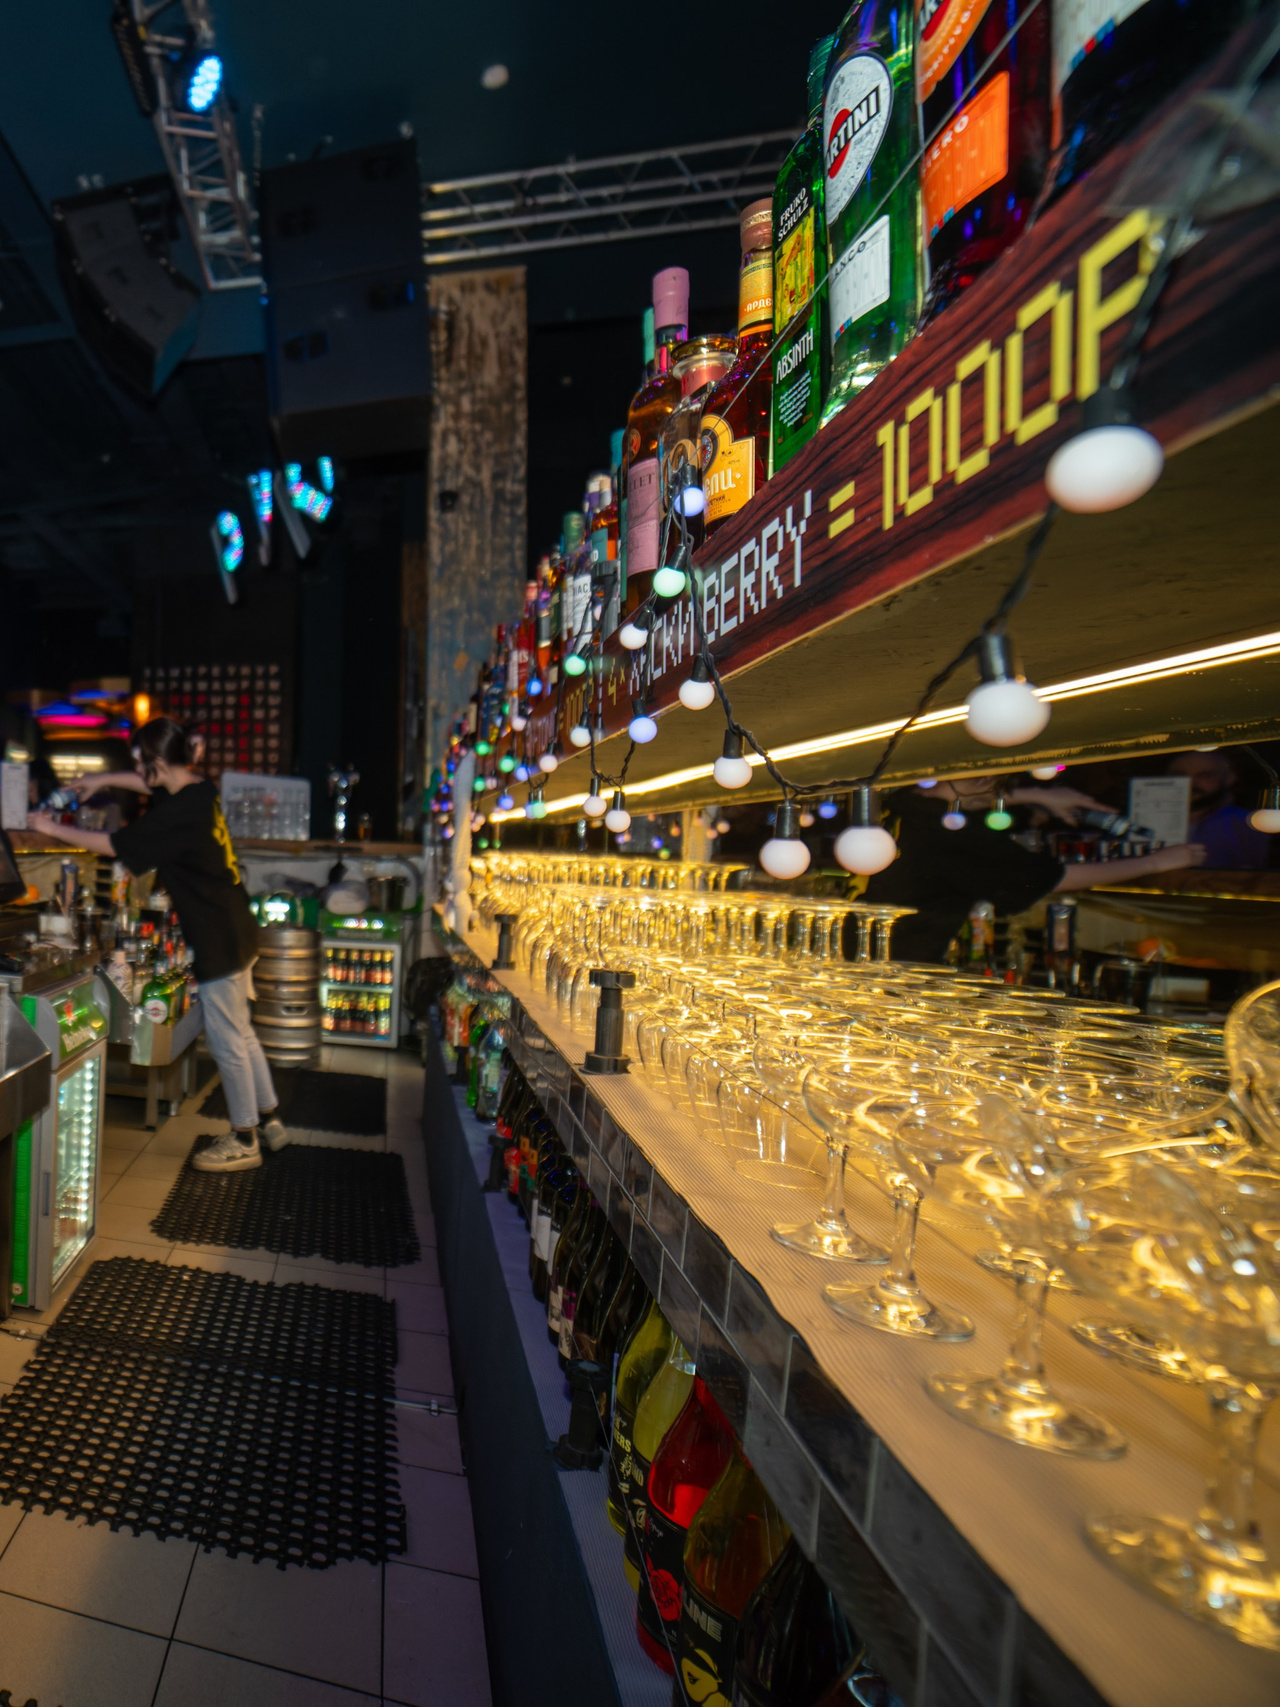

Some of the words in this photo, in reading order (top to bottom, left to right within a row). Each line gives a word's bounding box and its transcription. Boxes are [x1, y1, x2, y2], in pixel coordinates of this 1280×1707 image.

[777, 196, 809, 242] SCHULZ
[779, 187, 807, 227] FRUKO
[775, 327, 814, 385] ABSINTH
[703, 489, 813, 646] BERRY
